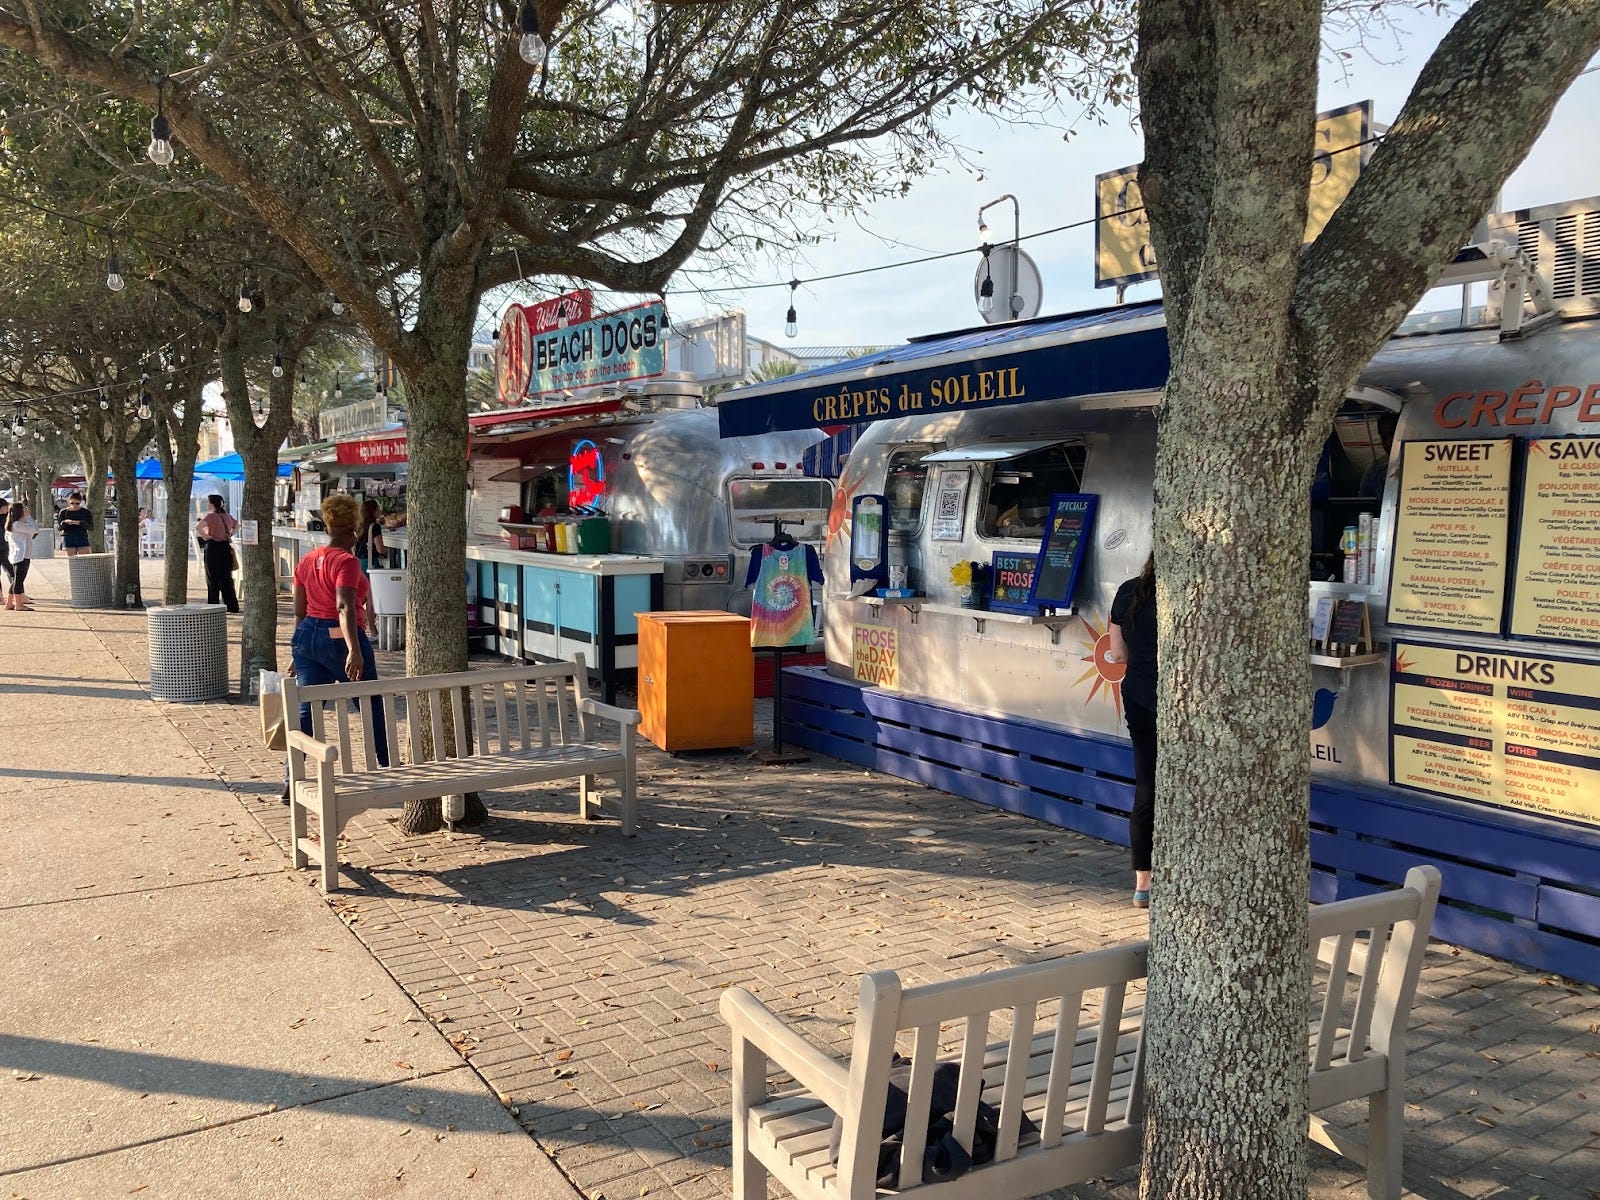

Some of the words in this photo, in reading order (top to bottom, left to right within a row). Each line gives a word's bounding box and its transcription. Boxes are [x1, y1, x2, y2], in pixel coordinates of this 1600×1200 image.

[536, 304, 559, 330] Wild
[537, 328, 592, 370] BEACH
[602, 315, 656, 358] DOGS
[564, 373, 573, 382] top
[575, 370, 586, 382] dog
[590, 368, 598, 378] on
[600, 365, 610, 375] the
[613, 360, 636, 374] beach
[813, 386, 892, 422] CRÊPES
[898, 384, 923, 411] du
[931, 367, 1025, 407] SOLEIL
[1424, 444, 1494, 461] SWEET
[1549, 442, 1600, 459] SAV
[1057, 501, 1088, 510] SPECIALS
[997, 557, 1020, 569] BEST
[1543, 562, 1569, 570] CRÊPE
[1410, 575, 1445, 583] BANANAS
[1540, 615, 1578, 624] CORDON
[856, 627, 895, 649] FROSÉ
[857, 663, 895, 685] AWAY
[1457, 654, 1554, 685] DRINKS
[1426, 678, 1457, 688] FROZEN
[1460, 683, 1491, 693] DRINKS
[1510, 689, 1534, 698] WINE
[1407, 707, 1436, 717] FROZEN
[1507, 703, 1528, 711] ROSÉ
[1449, 721, 1476, 730] lemonade
[1534, 727, 1568, 737] MIMOSA
[1469, 738, 1490, 748] BEER
[1536, 736, 1558, 744] Orange
[1507, 745, 1538, 757] OTHER
[1506, 758, 1536, 768] BOTTLED
[1505, 769, 1543, 781] SPARKLING
[1440, 780, 1455, 788] BEER
[1505, 779, 1525, 788] COCA
